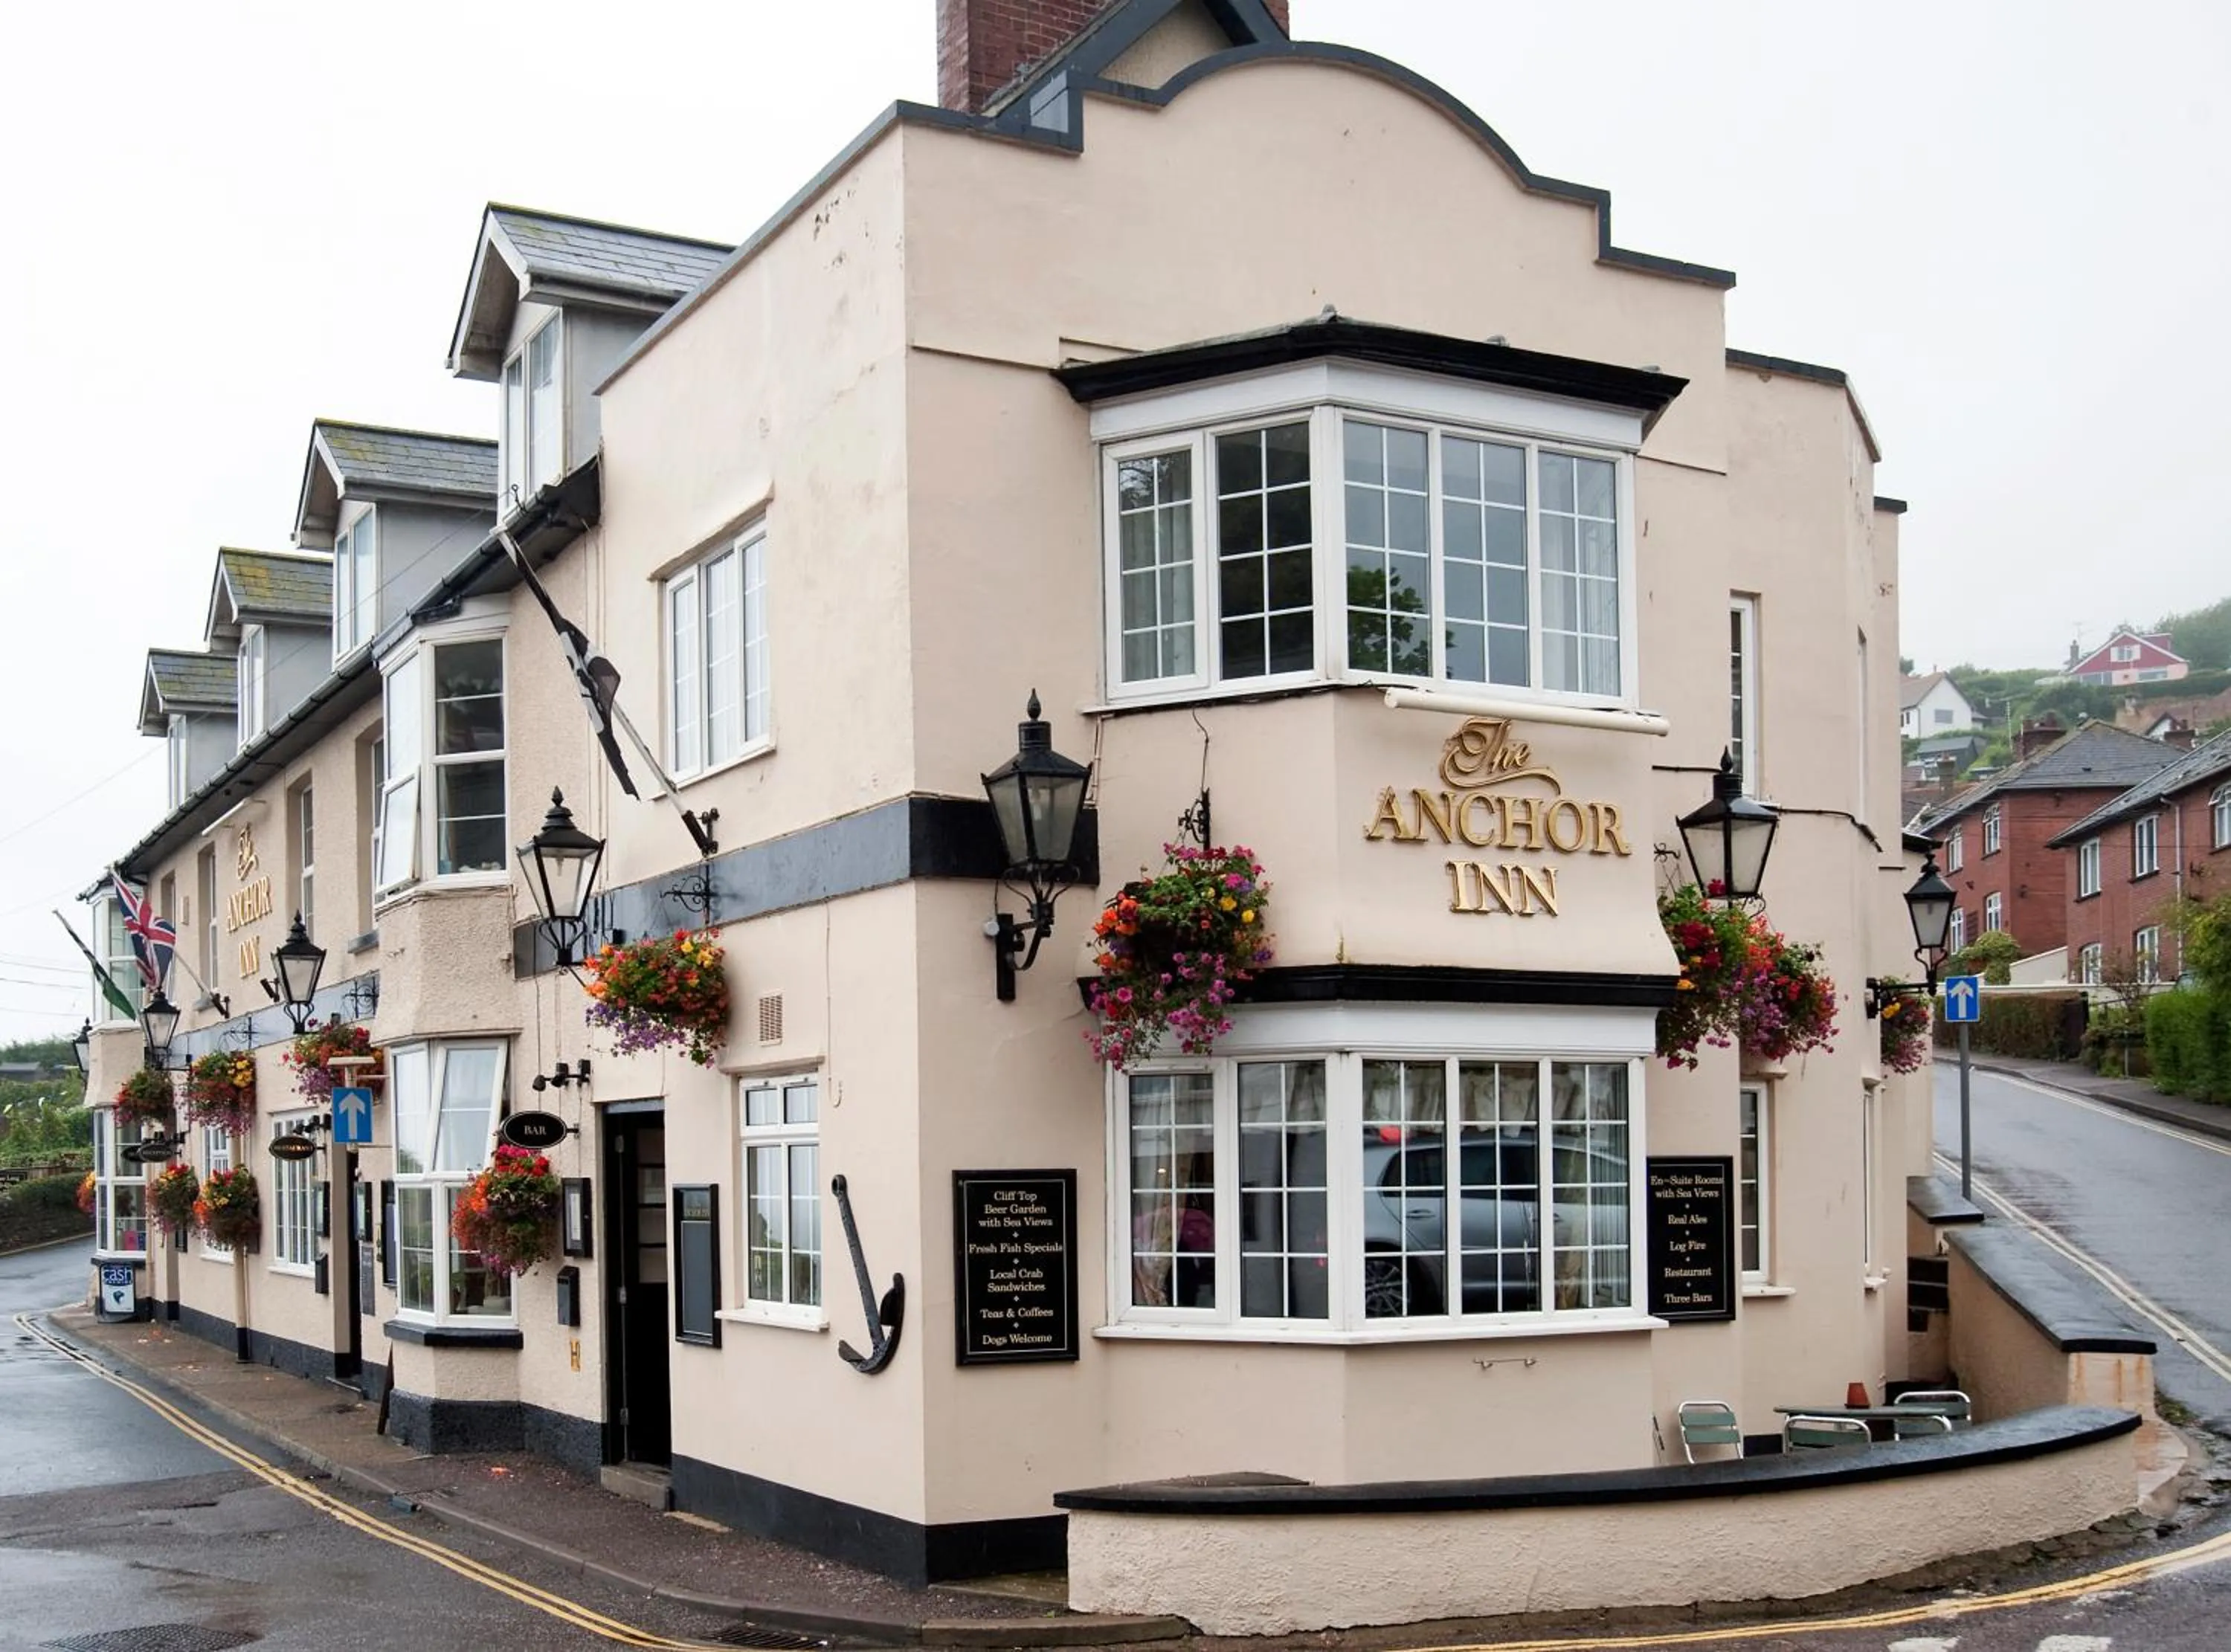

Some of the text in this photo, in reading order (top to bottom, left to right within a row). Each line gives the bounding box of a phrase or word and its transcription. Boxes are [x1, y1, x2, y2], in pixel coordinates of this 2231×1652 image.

[1440, 716, 1561, 795] The
[1366, 785, 1632, 856] ANCHOR
[1447, 862, 1559, 917] INN
[227, 875, 273, 933] ANCHOR
[239, 936, 260, 978] INN
[524, 1125, 547, 1135] BAR
[1650, 1175, 1693, 1185] En-Suite
[994, 1191, 1037, 1202] Cliff Top
[1655, 1187, 1719, 1198] with Sea Views
[985, 1204, 1046, 1214] Beer Garden
[978, 1216, 1053, 1227] with Sea Views
[1668, 1214, 1707, 1225] Real Ales
[969, 1242, 1063, 1254] Fresh Fish Specials
[1670, 1240, 1706, 1253] Log Fire
[103, 1267, 133, 1282] cash
[990, 1268, 1043, 1280] Local Crab
[1664, 1268, 1712, 1277] Restaurant
[987, 1281, 1046, 1292] Sandwiches
[1664, 1293, 1713, 1303] Three Bars
[979, 1307, 1054, 1318] Teas & Coffees
[982, 1333, 1052, 1346] Dogs Welcome
